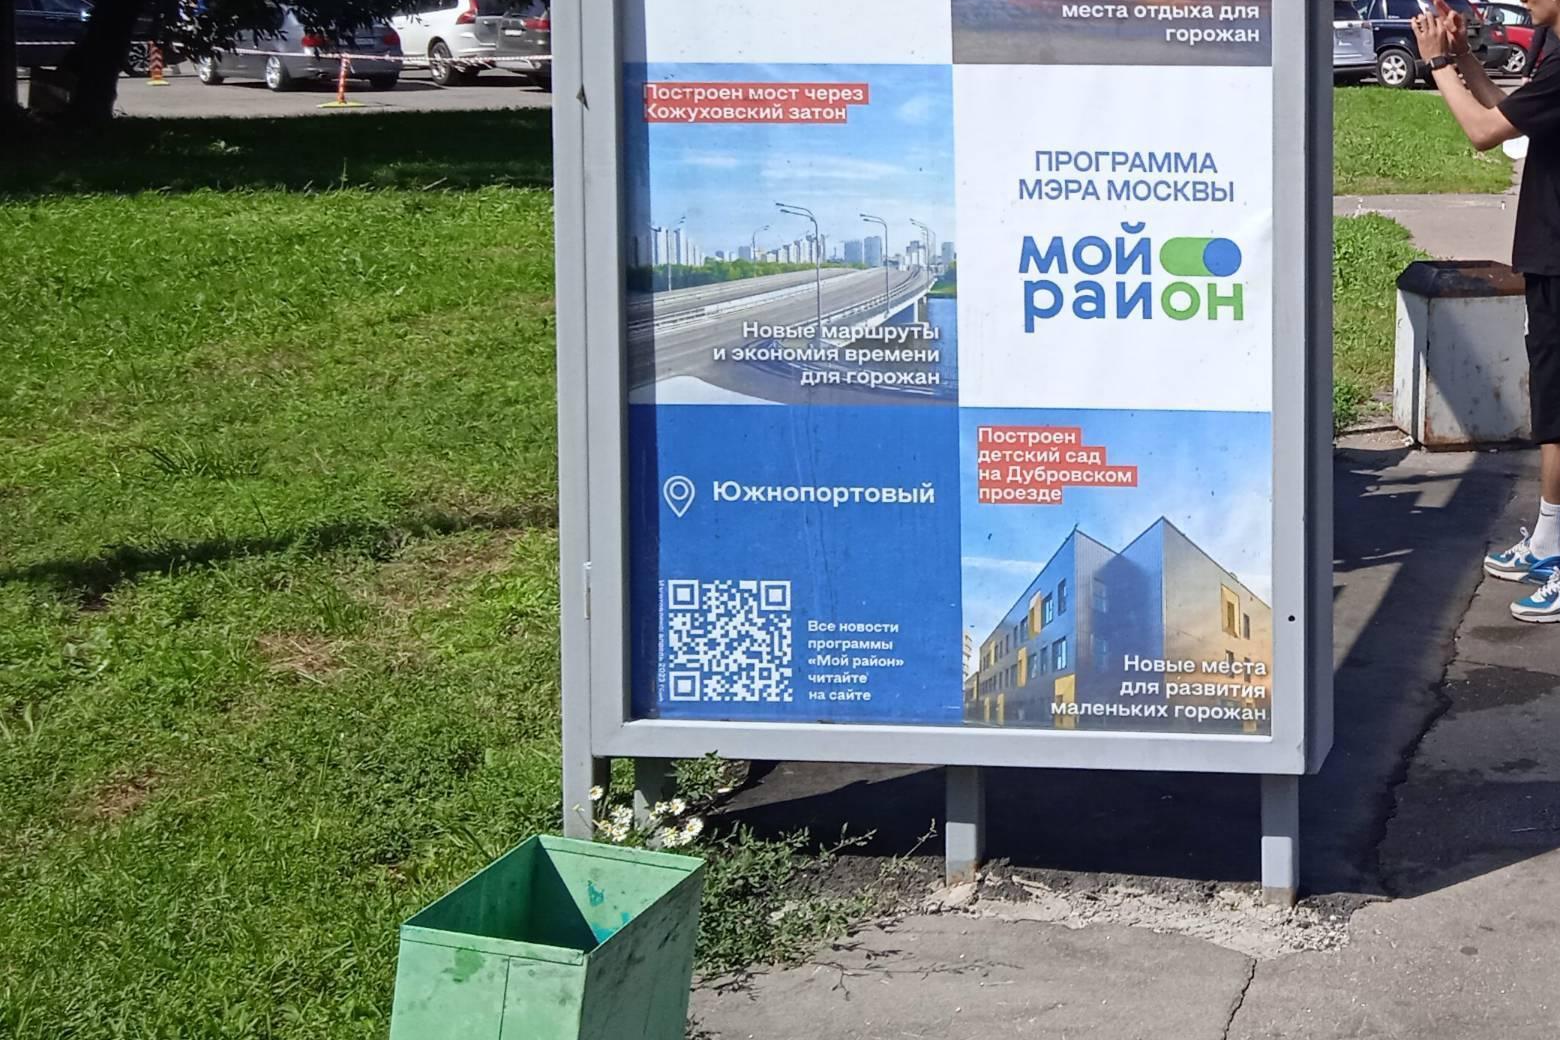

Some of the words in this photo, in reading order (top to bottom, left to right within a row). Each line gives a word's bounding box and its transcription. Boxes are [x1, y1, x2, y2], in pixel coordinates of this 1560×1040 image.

[1062, 5, 1128, 18] места
[1134, 5, 1214, 20] отдыха
[1219, 6, 1259, 20] для
[1166, 28, 1259, 45] горожан
[645, 85, 743, 103] Построен
[749, 88, 799, 99] мост
[805, 89, 863, 103] через
[645, 104, 783, 122] Кожуховский
[789, 107, 846, 119] затон
[1036, 151, 1218, 173] ПРОГРАММА
[1019, 179, 1100, 200] МЭРА
[1107, 180, 1234, 202] МОСКВЫ
[743, 322, 815, 338] Новые
[821, 327, 939, 342] маршруты
[714, 348, 725, 359] и
[732, 348, 839, 360] экономия
[846, 349, 939, 365] времени
[801, 371, 840, 385] для
[847, 372, 939, 388] горожан
[978, 428, 1075, 446] Построен
[978, 447, 1060, 463] детский
[1065, 451, 1101, 464] сад
[979, 469, 1001, 480] на
[1007, 466, 1132, 484] Дубровском
[713, 481, 935, 507] Южнопортовый
[979, 488, 1062, 502] проезде
[808, 621, 836, 632] Все
[839, 622, 899, 633] новости
[808, 639, 893, 652] программы
[808, 655, 849, 667] «Мой
[853, 656, 904, 669] район»
[1124, 655, 1195, 672] Новые
[1202, 661, 1267, 676] места
[808, 673, 868, 683] читайте
[809, 690, 825, 700] на
[829, 689, 871, 701] сайте
[1120, 681, 1159, 695] для
[1166, 683, 1266, 698] развития
[1051, 702, 1168, 717] маленьких
[1175, 704, 1266, 722] горожан
